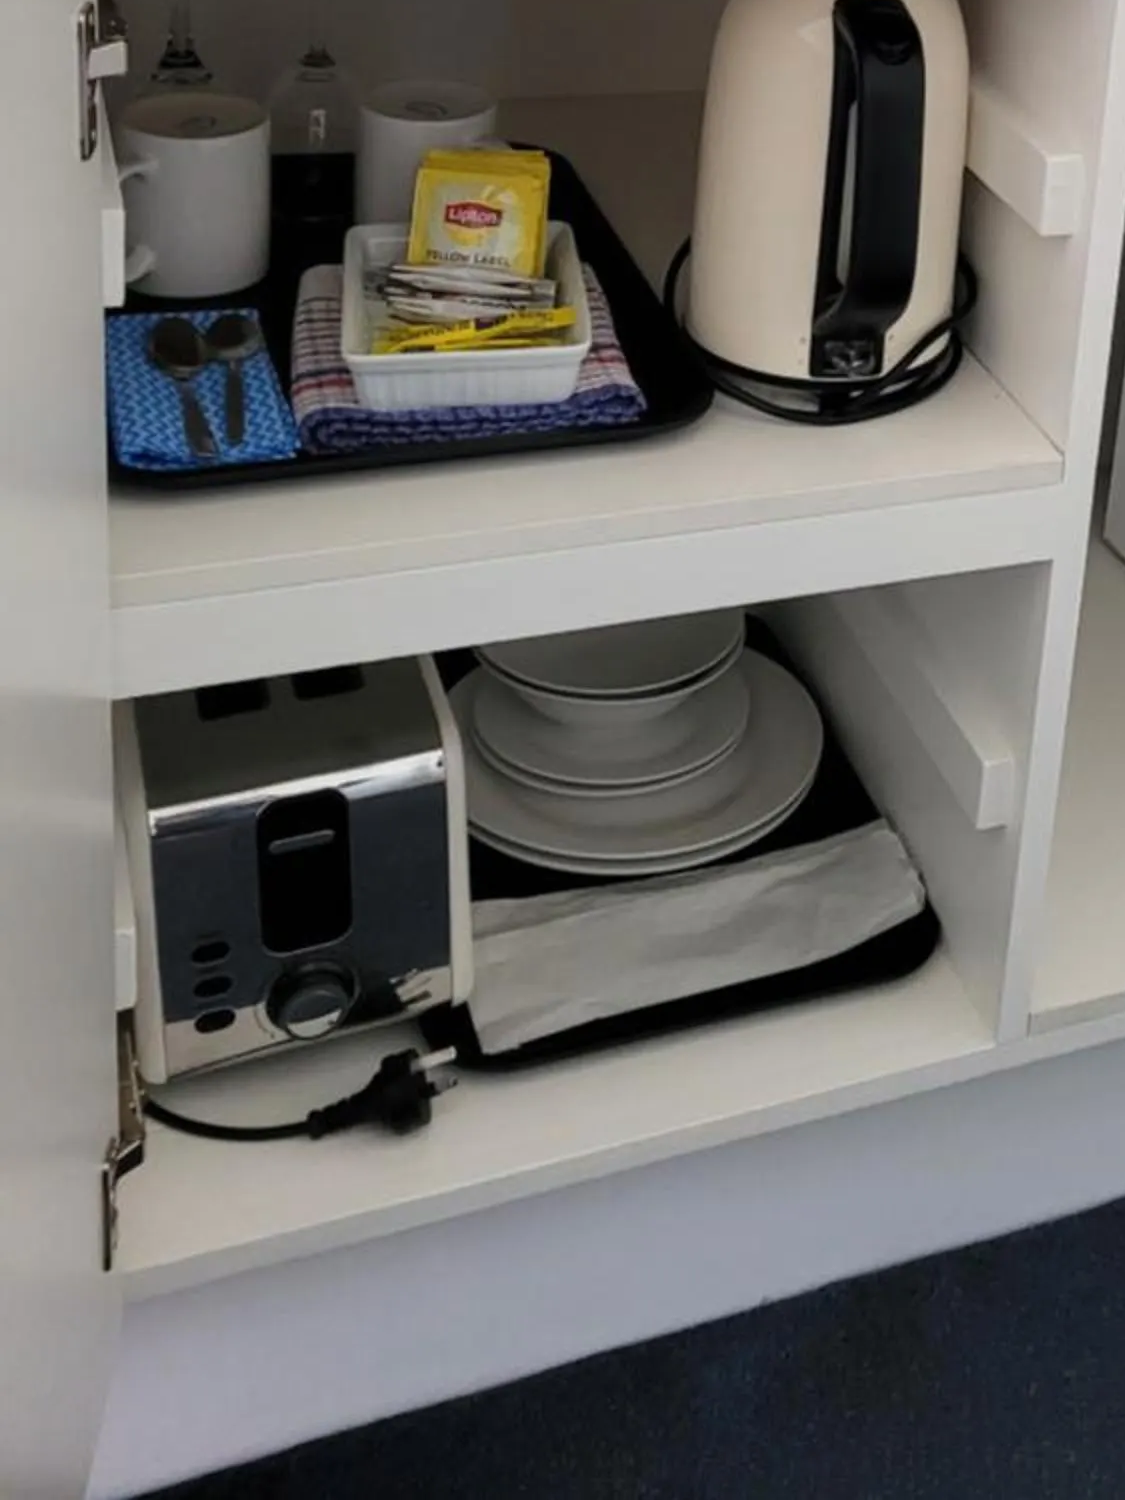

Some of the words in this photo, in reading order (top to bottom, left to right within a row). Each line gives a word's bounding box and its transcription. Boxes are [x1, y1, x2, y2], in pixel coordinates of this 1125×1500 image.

[448, 205, 499, 225] Lipton
[425, 249, 470, 262] YELLOW
[474, 253, 511, 267] LABEL
